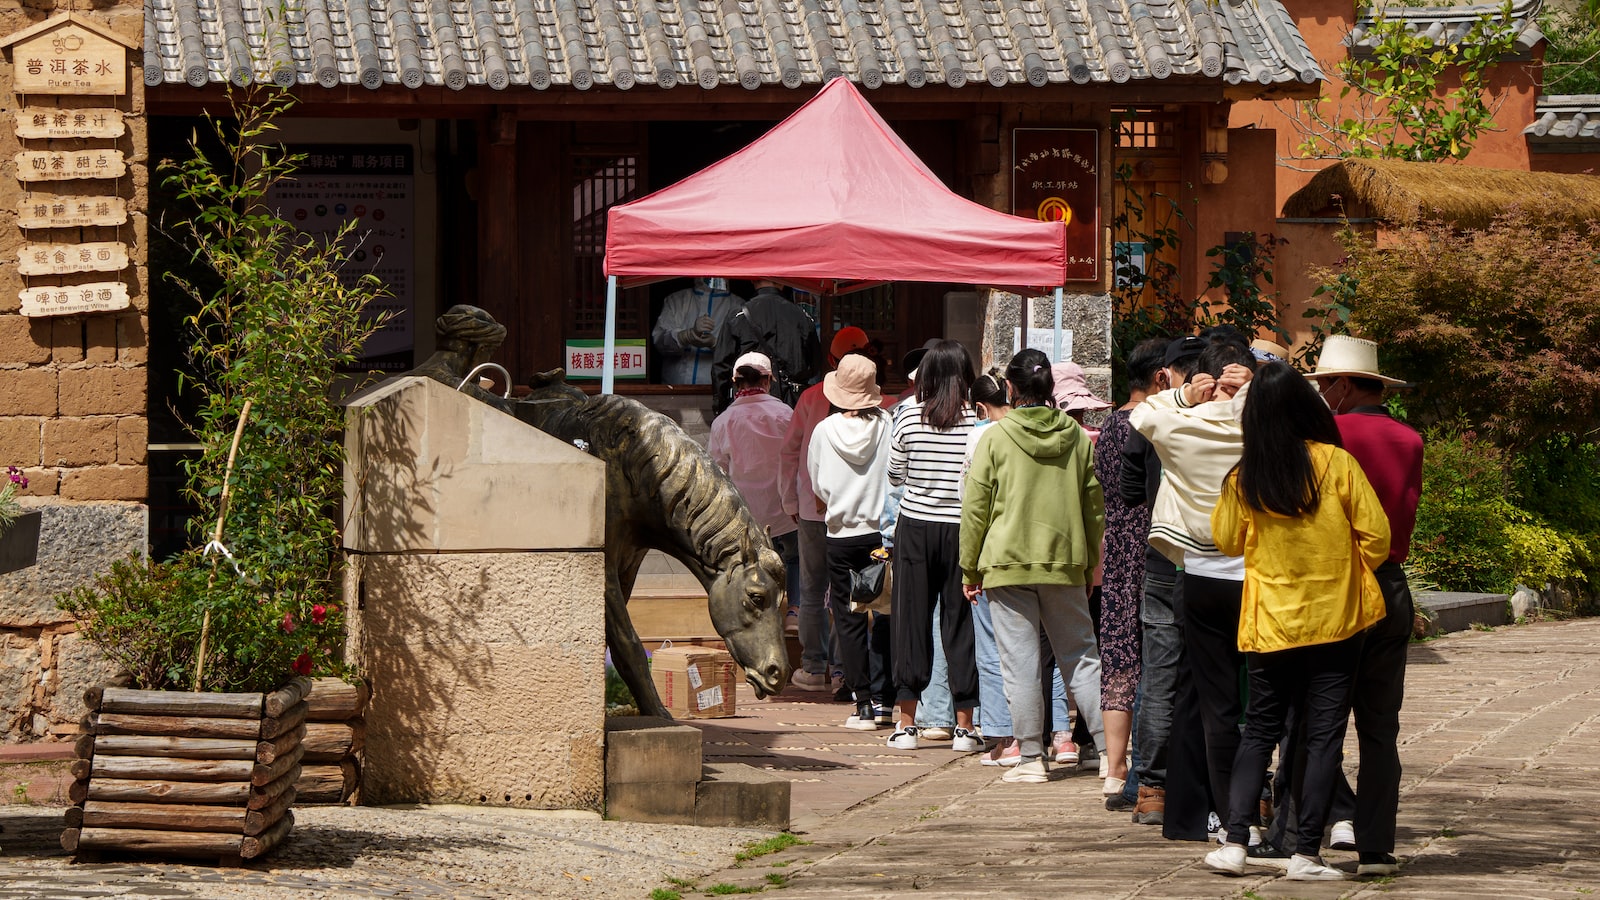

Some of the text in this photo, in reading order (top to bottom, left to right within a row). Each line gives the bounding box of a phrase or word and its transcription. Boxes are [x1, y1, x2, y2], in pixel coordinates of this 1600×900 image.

[26, 58, 113, 76] 普洱茶水
[48, 79, 91, 87] Pu'er Tea
[32, 114, 107, 128] 鲜榨果汁
[351, 154, 405, 169] 服务项目
[1032, 181, 1079, 190] 职工驿站
[59, 304, 89, 312] Brewing
